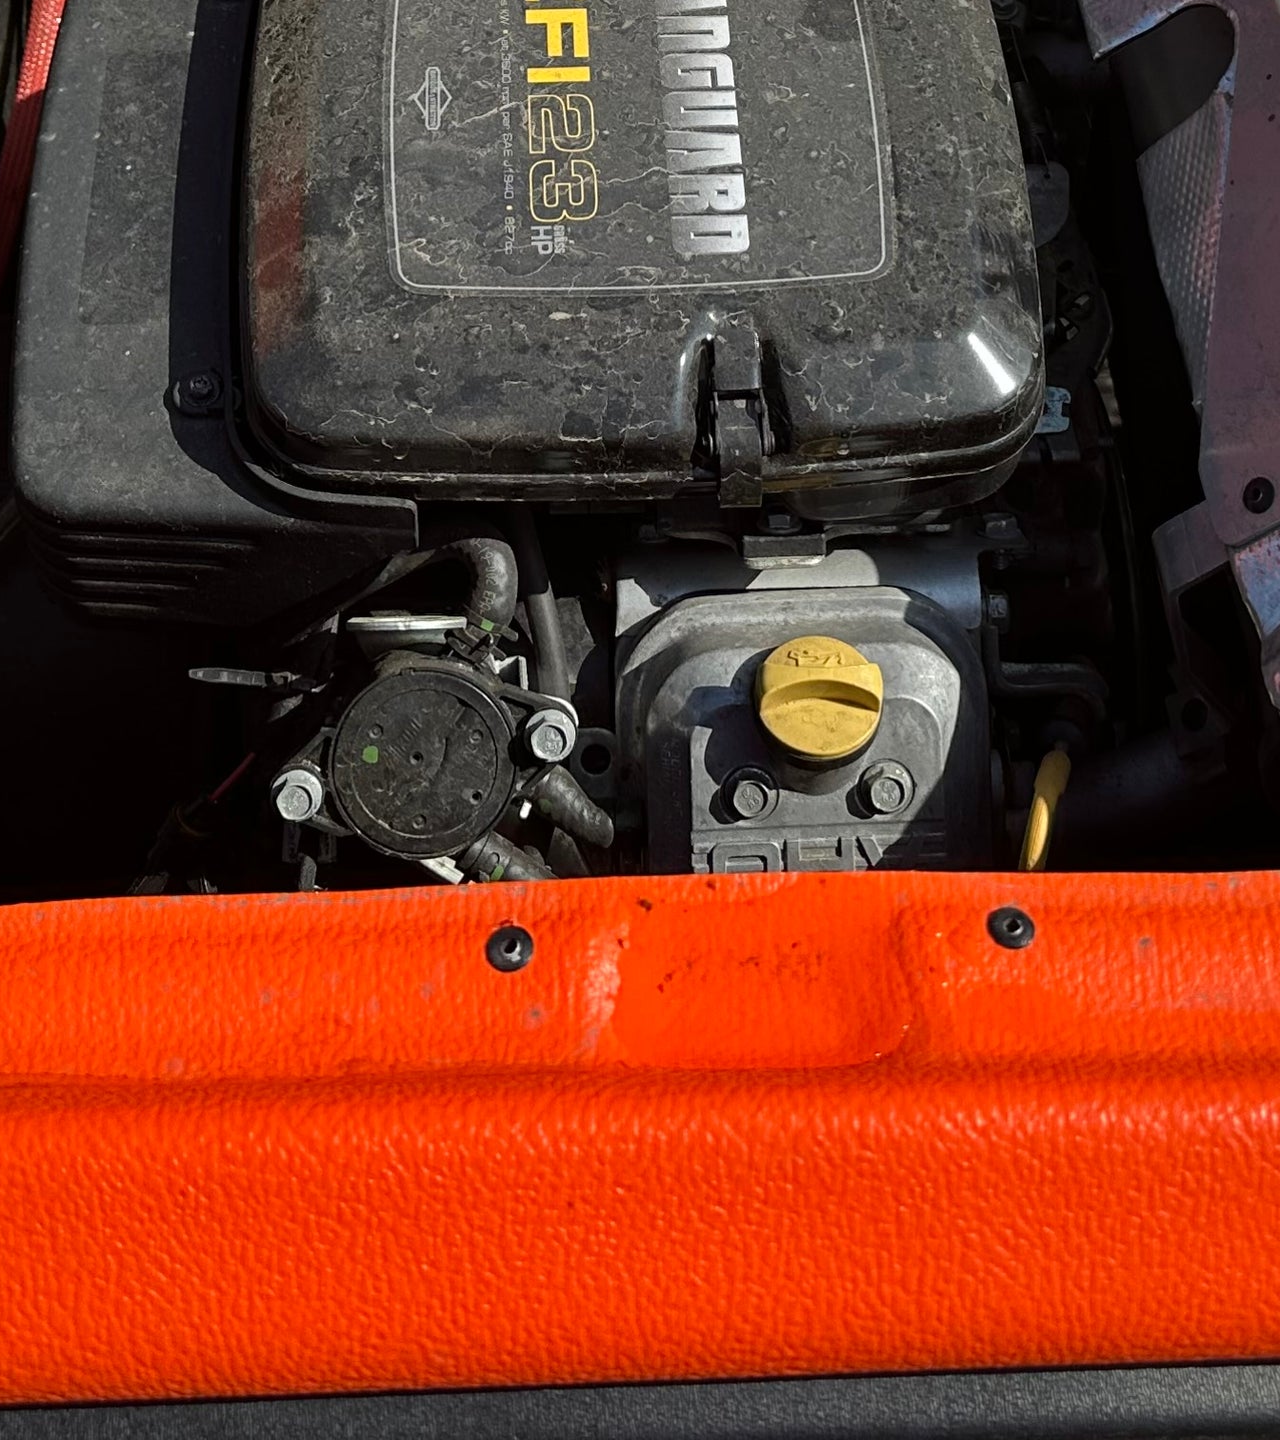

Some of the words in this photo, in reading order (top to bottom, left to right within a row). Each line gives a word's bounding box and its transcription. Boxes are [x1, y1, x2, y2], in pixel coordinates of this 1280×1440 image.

[503, 133, 513, 156] SAE
[527, 93, 599, 224] 23
[503, 160, 514, 199] J1940
[530, 226, 553, 255] HP
